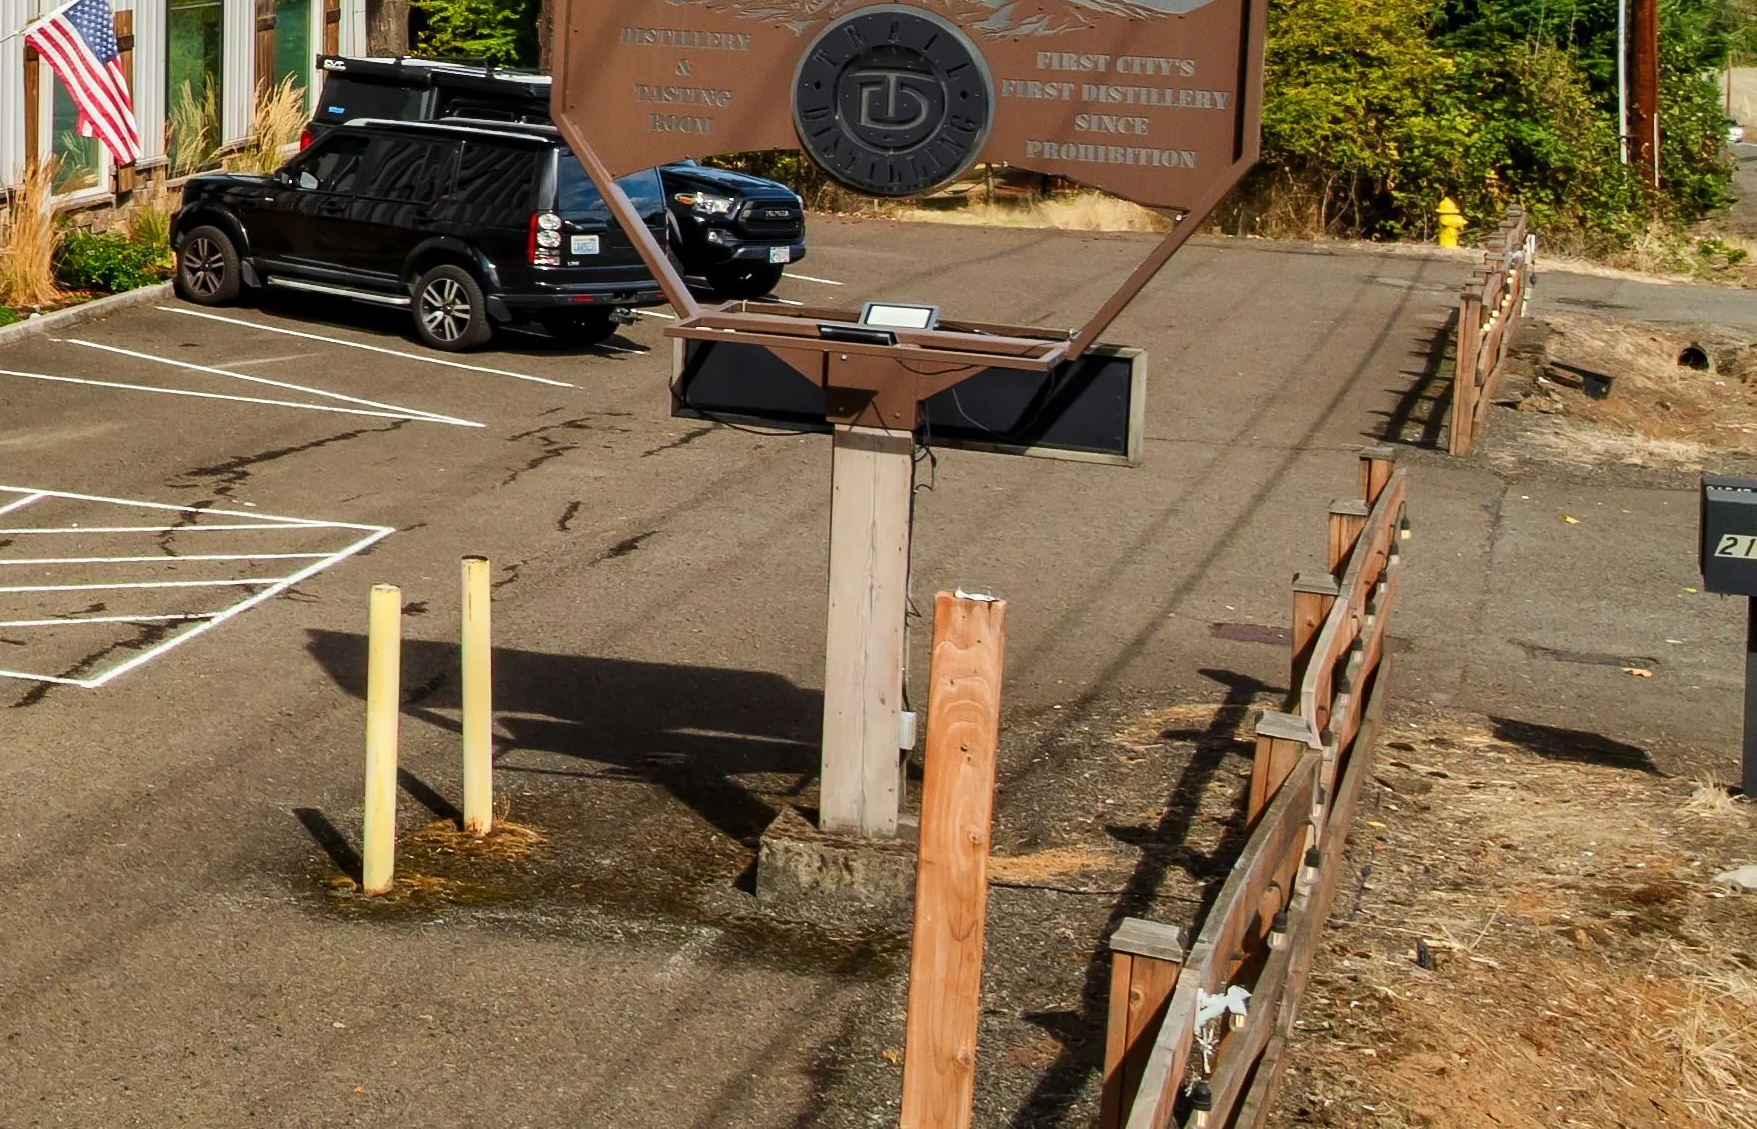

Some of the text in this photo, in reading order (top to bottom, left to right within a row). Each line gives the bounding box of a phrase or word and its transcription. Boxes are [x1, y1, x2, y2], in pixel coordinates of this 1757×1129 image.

[620, 26, 752, 52] DISTILLERY
[675, 58, 693, 77] &
[1037, 51, 1196, 78] FIRST CITY'S
[634, 84, 733, 108] TASTING
[1001, 79, 1229, 110] FIRST DISTILLERY
[649, 113, 714, 135] ROOM
[1074, 113, 1150, 135] SINCE
[1026, 140, 1197, 168] PROHIBITION
